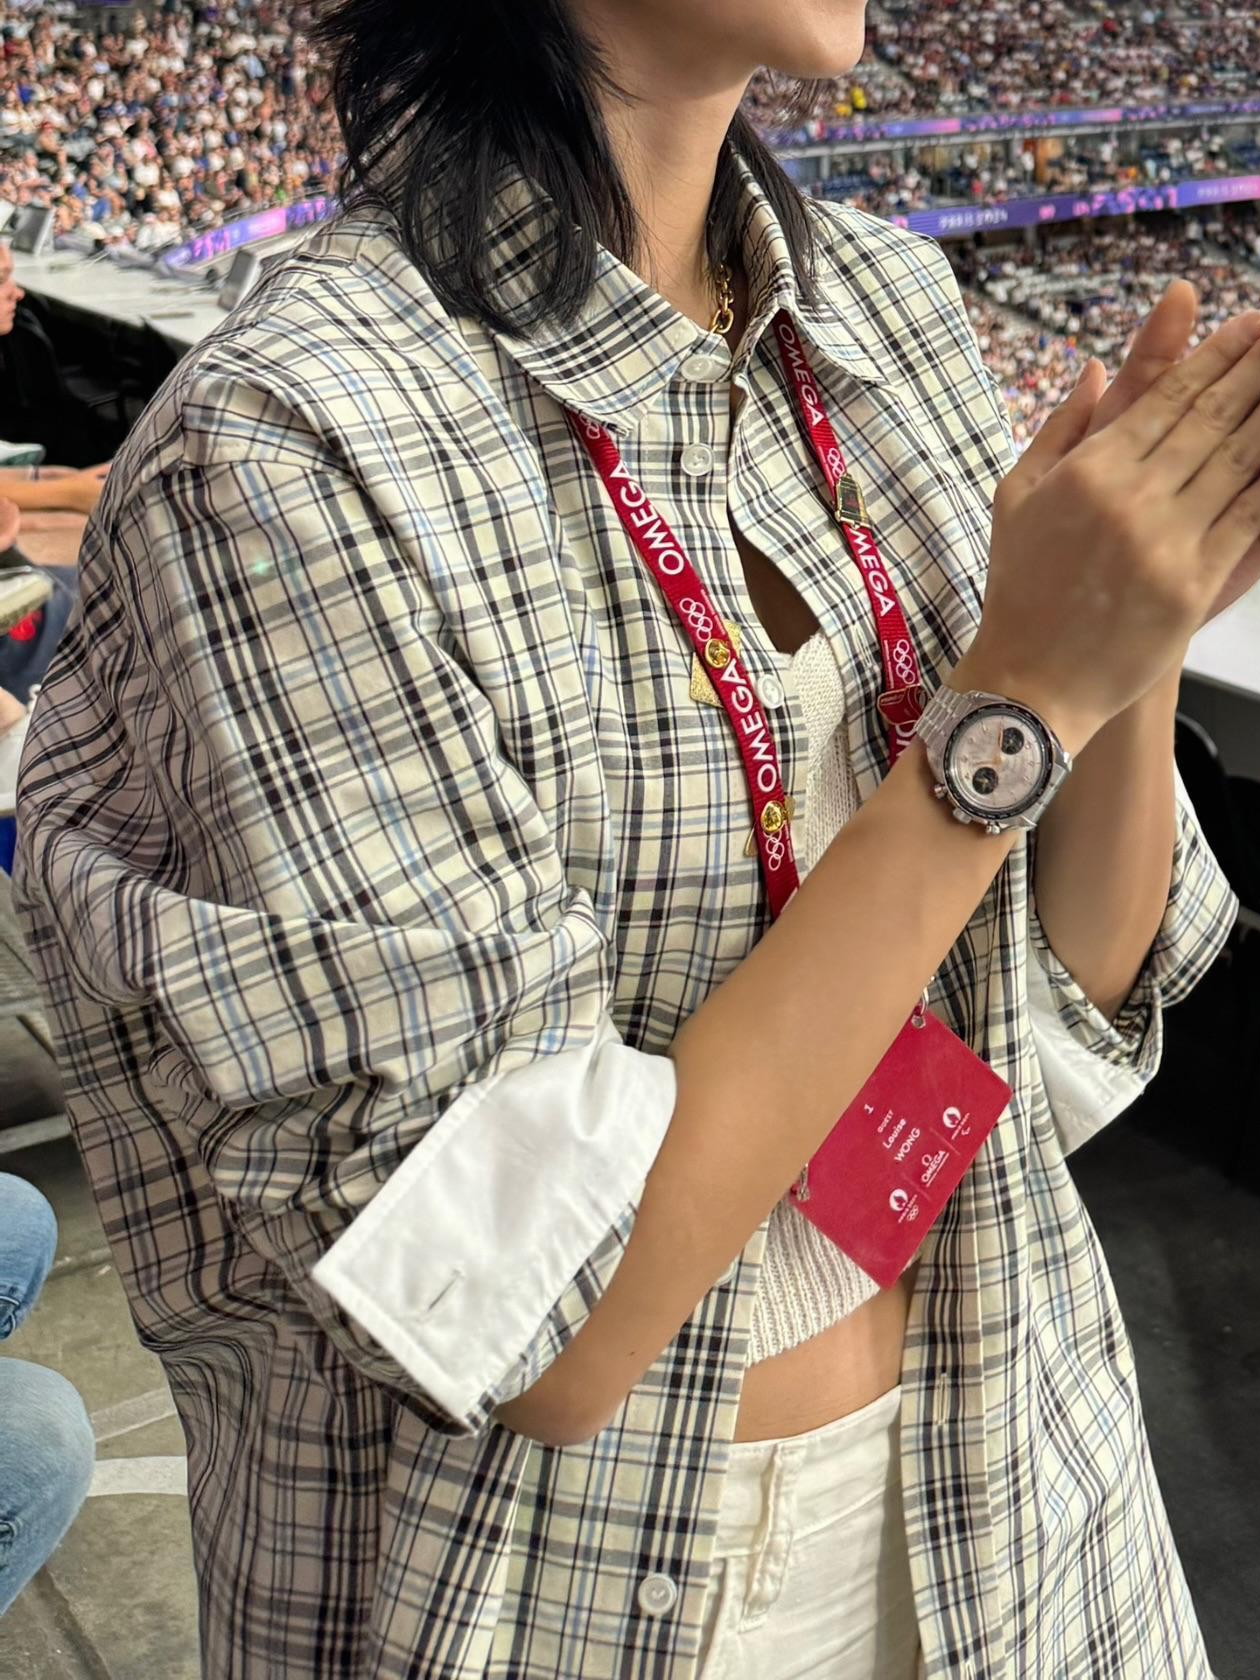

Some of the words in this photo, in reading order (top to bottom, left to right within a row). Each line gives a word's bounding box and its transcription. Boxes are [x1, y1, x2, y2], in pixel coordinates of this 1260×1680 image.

[779, 323, 825, 427] OMEGA
[609, 458, 685, 575] OMEGA
[849, 526, 896, 617] MEGA
[720, 657, 777, 793] OMEGA
[863, 1103, 874, 1115] 1
[882, 1118, 907, 1149] Louise
[894, 1127, 921, 1161] WONG
[921, 1150, 946, 1182] OMEGA
